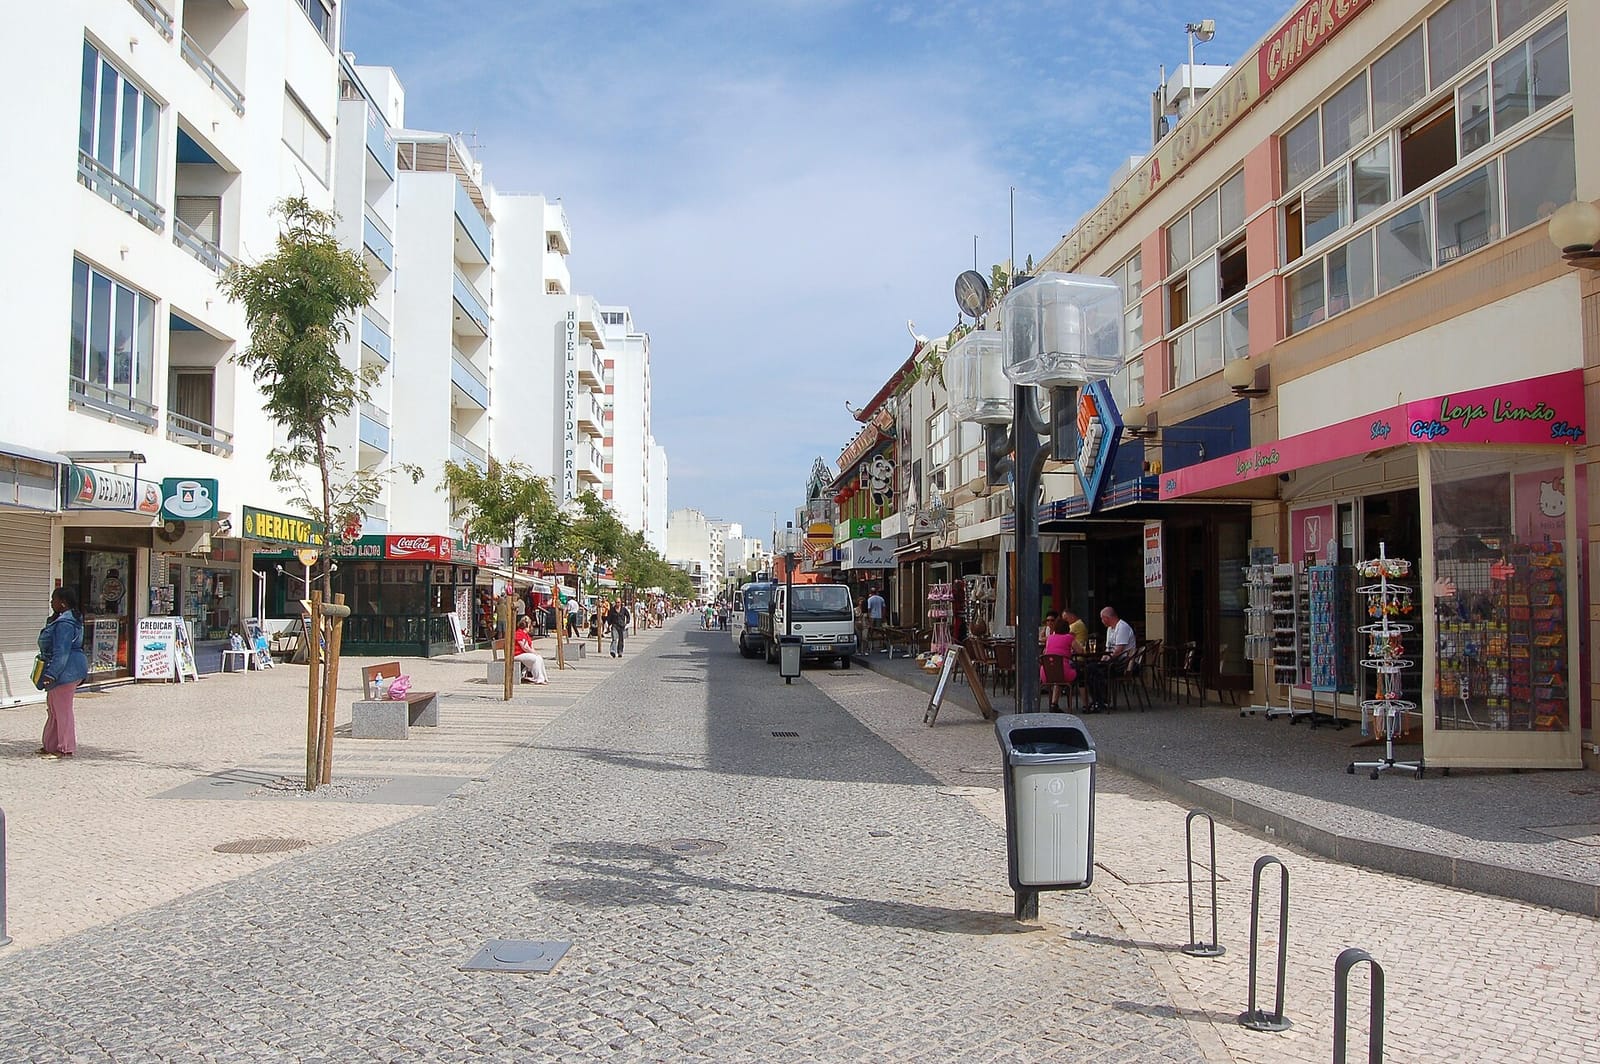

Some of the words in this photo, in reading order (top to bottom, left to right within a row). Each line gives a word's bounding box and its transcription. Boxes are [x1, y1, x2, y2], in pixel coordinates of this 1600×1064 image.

[566, 311, 575, 361] HOTEL
[565, 370, 575, 441] AVENIDA
[1440, 397, 1489, 428] Loja
[1492, 397, 1557, 423] Limão
[1370, 419, 1392, 441] Shop
[1410, 419, 1449, 440] Gifts
[1550, 421, 1586, 440] Shop
[564, 449, 574, 500] PRAIA
[358, 544, 381, 556] LION
[140, 622, 172, 630] CREDICAR
